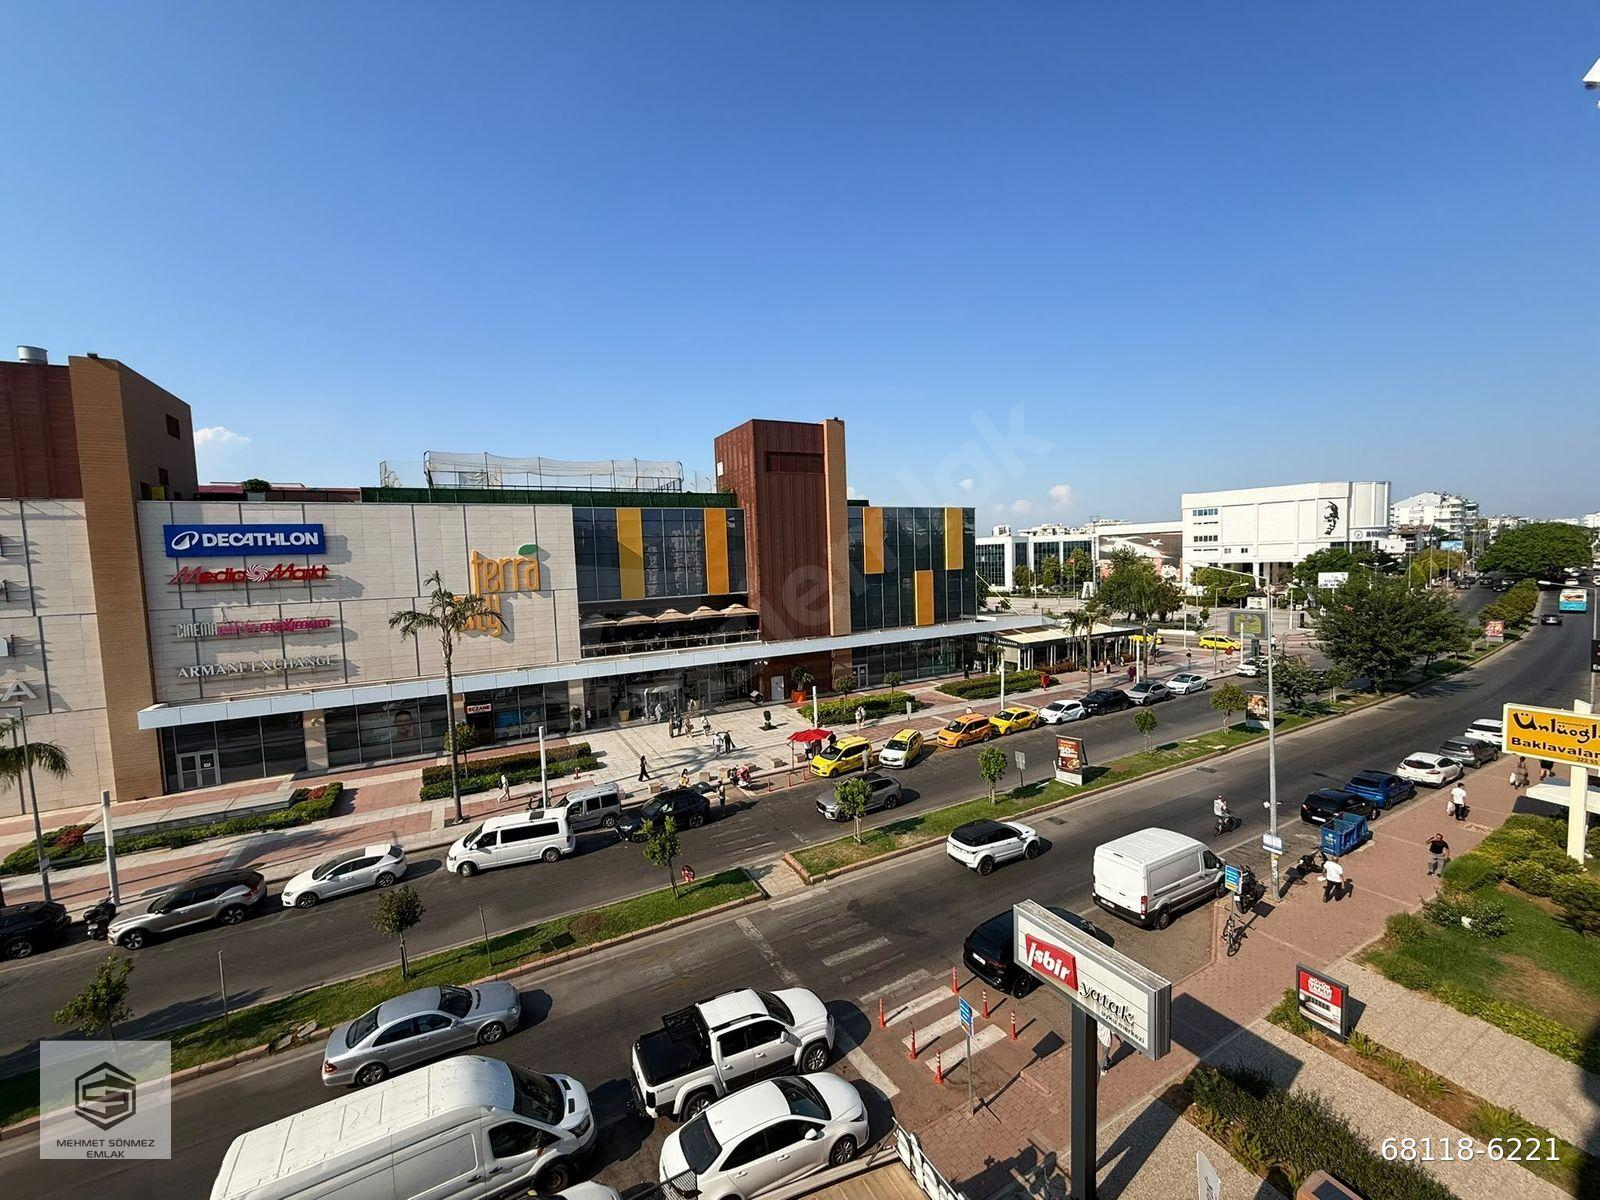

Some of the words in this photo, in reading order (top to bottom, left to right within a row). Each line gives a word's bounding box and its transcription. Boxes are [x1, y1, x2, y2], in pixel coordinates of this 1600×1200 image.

[202, 532, 319, 547] DECATHLON
[168, 565, 247, 585] Media
[268, 563, 330, 582] Markt
[471, 549, 539, 599] terra
[178, 662, 244, 678] ARMANI
[1079, 981, 1135, 1026] yatak
